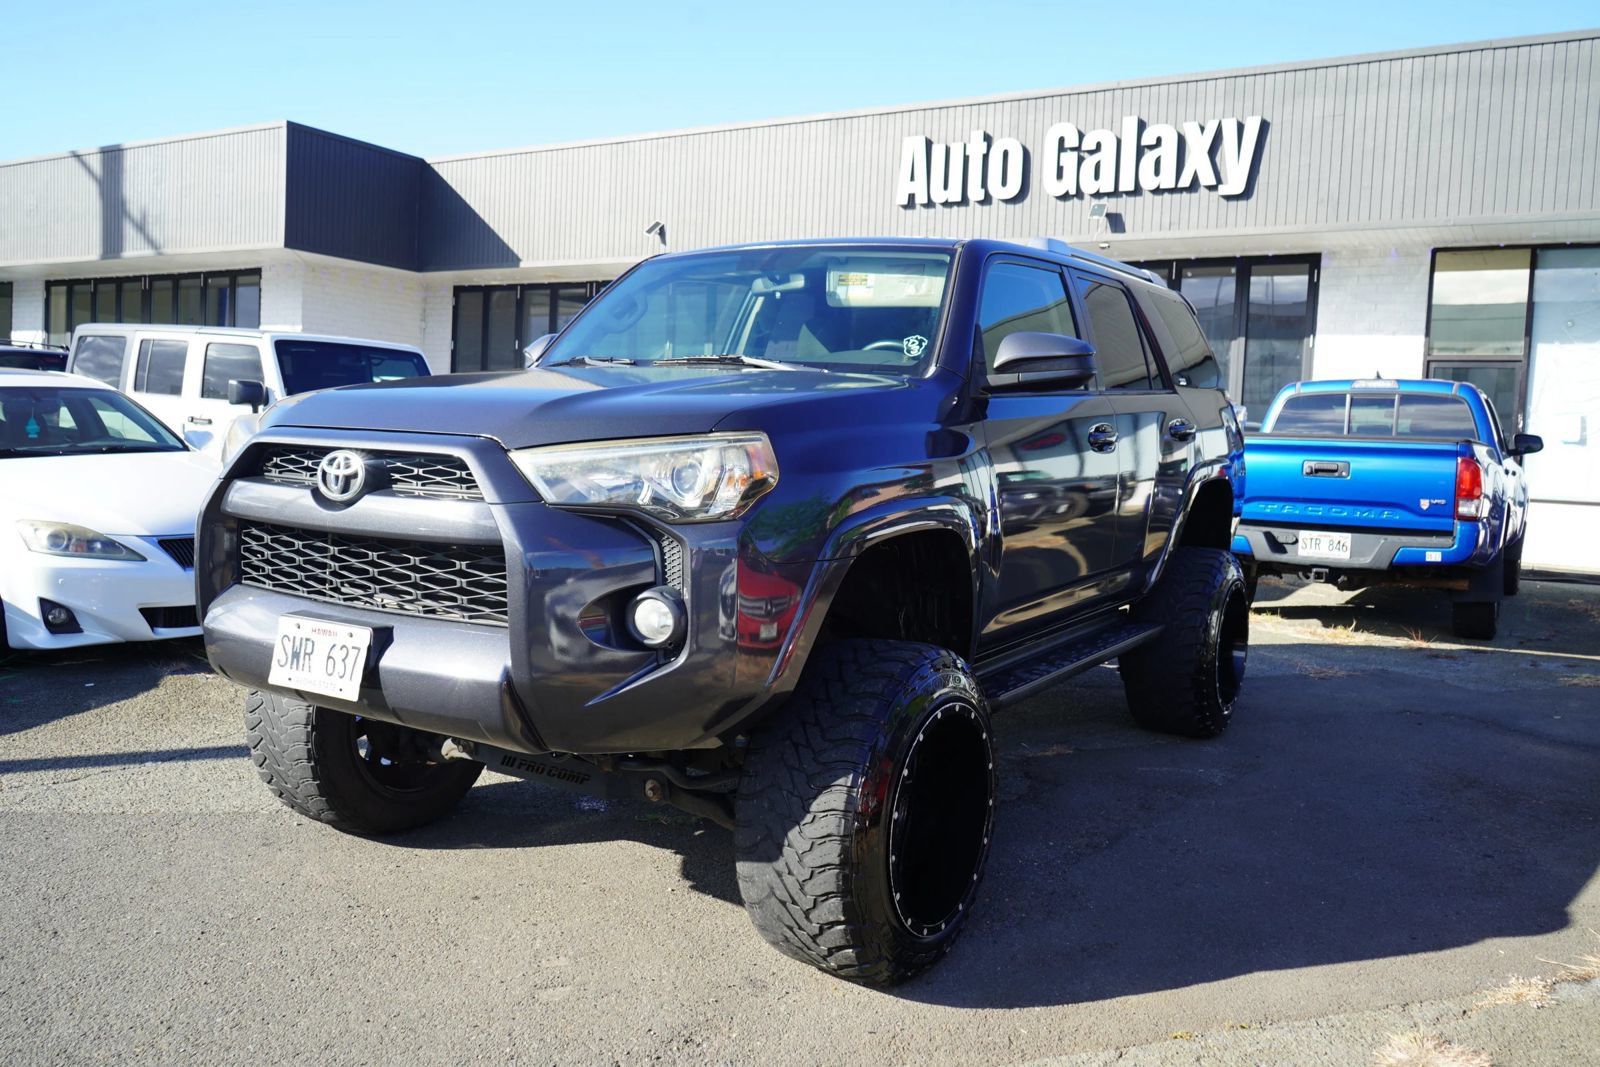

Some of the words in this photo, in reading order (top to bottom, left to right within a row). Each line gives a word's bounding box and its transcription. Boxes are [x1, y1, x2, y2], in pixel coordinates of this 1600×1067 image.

[896, 130, 1026, 206] Auto
[1043, 115, 1265, 199] Galaxy
[1258, 503, 1400, 520] TACOMA
[1301, 537, 1321, 551] STR
[1328, 539, 1348, 553] 846
[277, 634, 315, 673] SWR
[325, 643, 361, 682] 637
[517, 758, 546, 775] PRO
[546, 766, 591, 785] COMP
